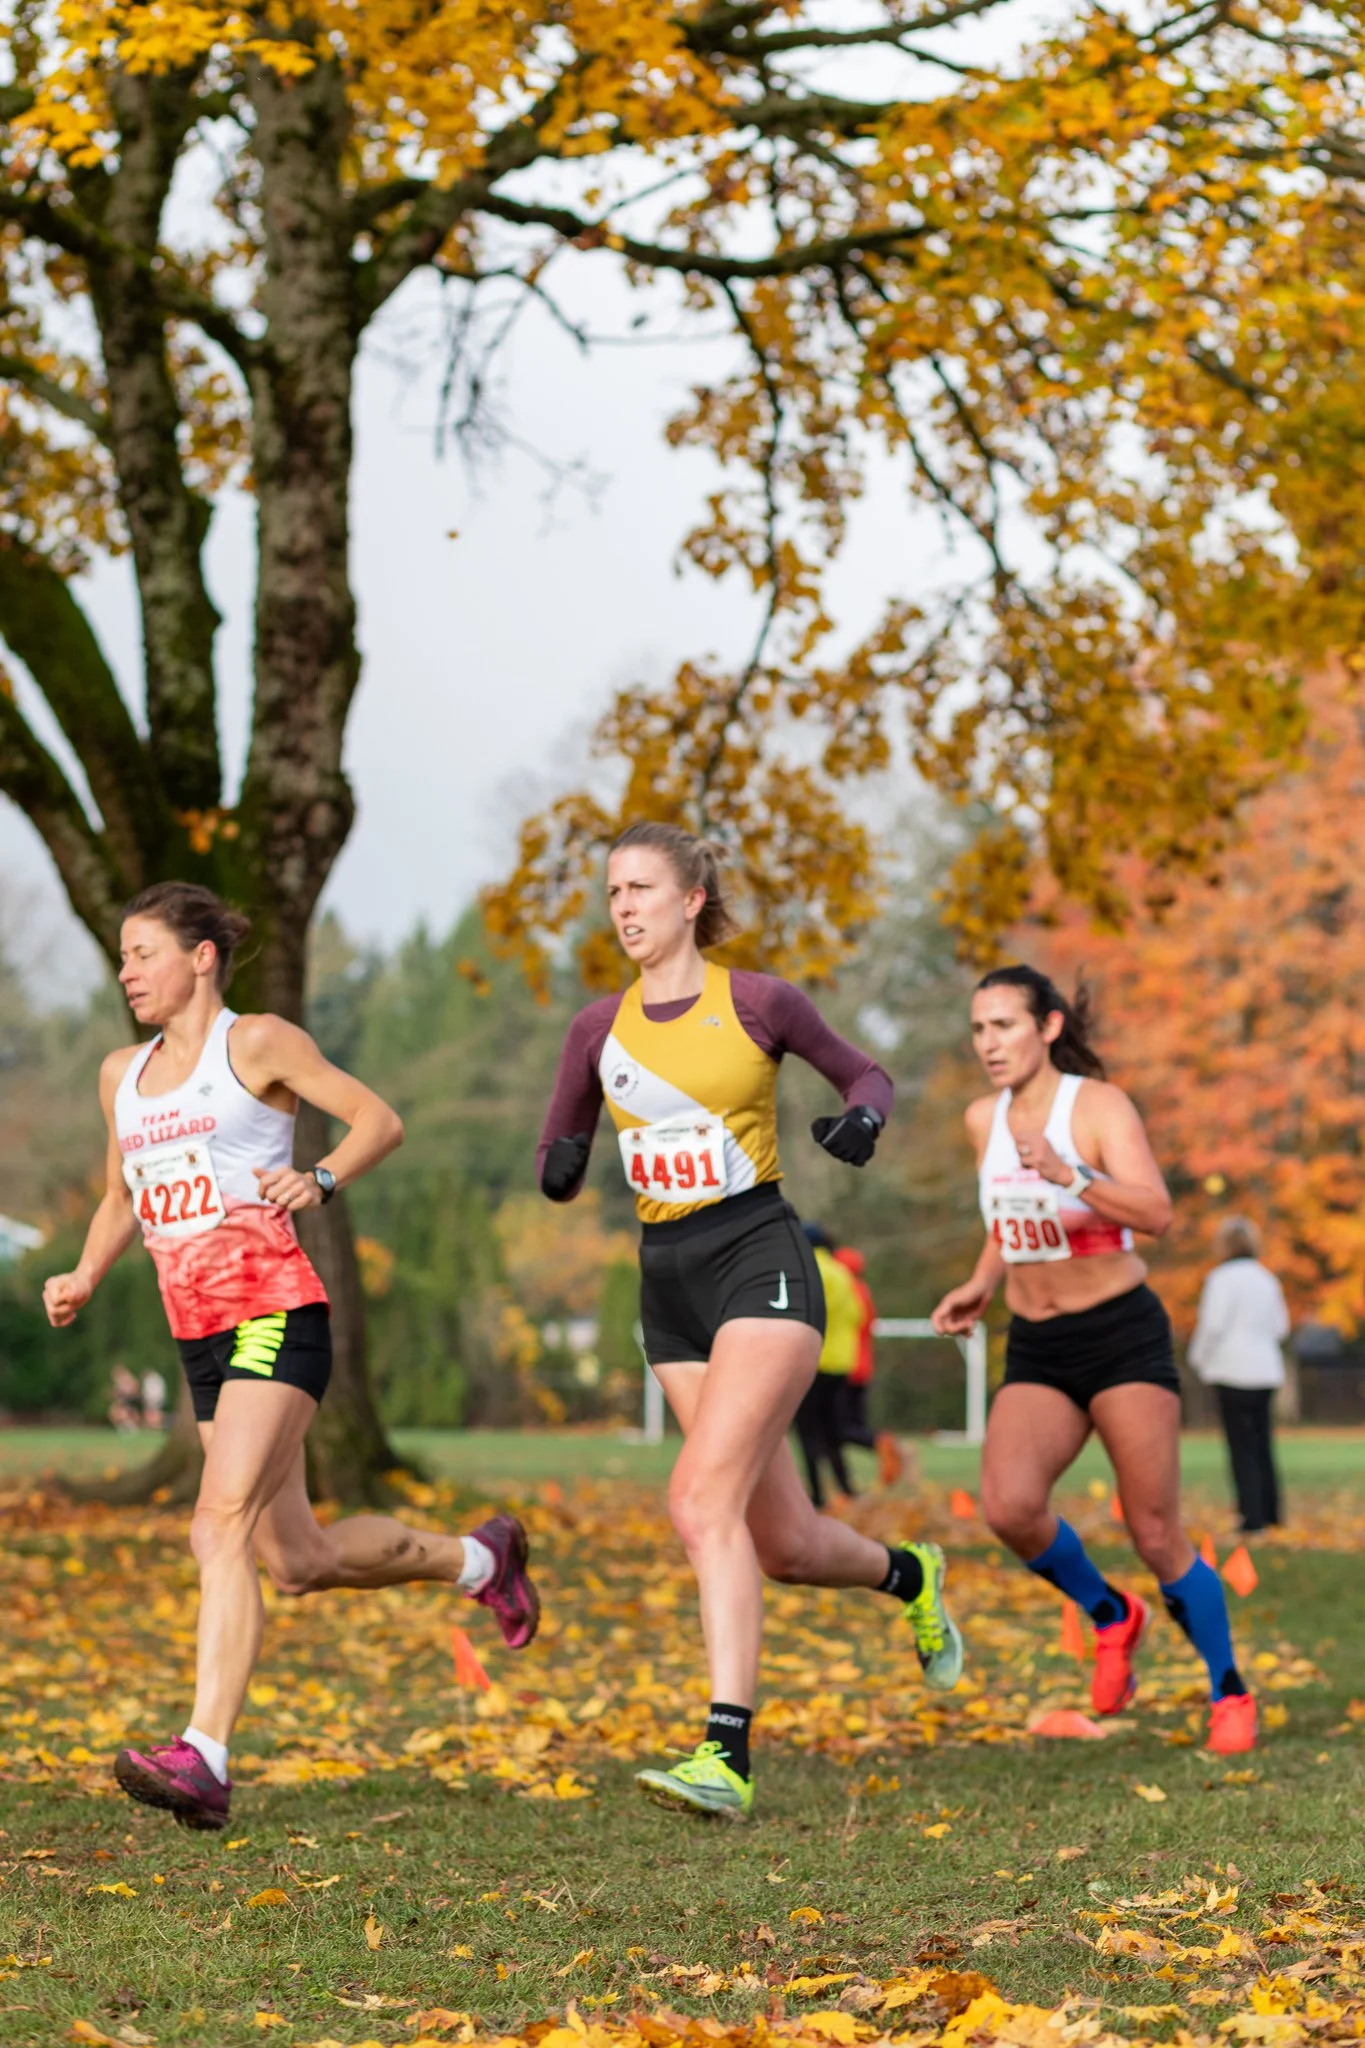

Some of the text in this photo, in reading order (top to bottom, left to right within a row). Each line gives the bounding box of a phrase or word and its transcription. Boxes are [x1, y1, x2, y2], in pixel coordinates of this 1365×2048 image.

[142, 1109, 180, 1126] TEAM
[149, 1116, 216, 1144] LIZARD
[631, 1149, 720, 1190] 4491
[140, 1175, 218, 1226] 4222
[993, 1218, 1060, 1250] 4390
